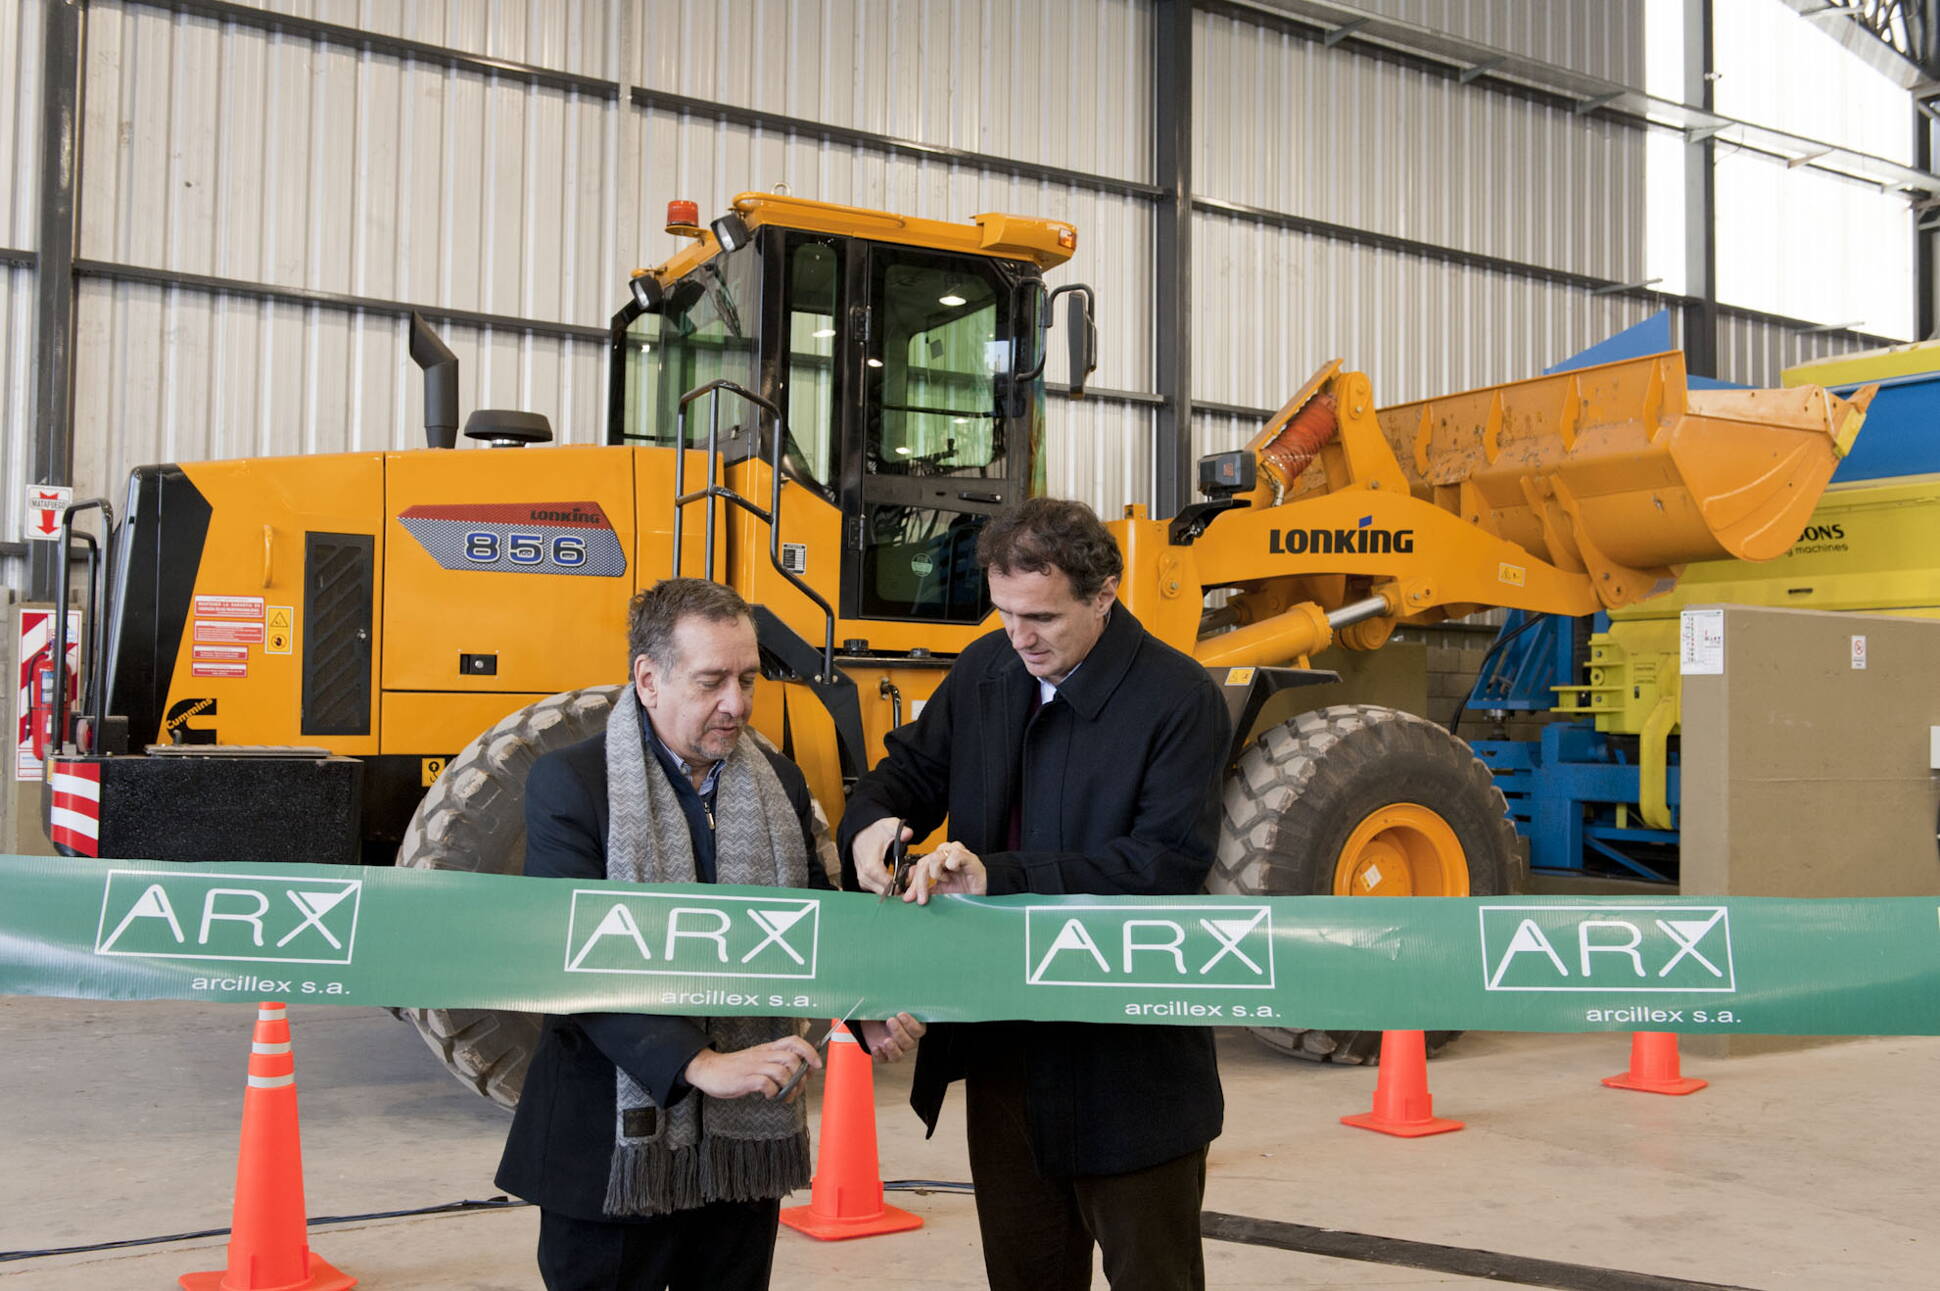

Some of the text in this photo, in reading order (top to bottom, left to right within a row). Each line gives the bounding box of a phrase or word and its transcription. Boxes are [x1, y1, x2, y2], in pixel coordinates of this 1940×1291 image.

[32, 499, 66, 509] MATAFUEGO
[464, 531, 588, 568] 856
[1795, 543, 1849, 555] machines
[166, 698, 214, 730] Cummins
[101, 882, 360, 954] ARX
[570, 901, 818, 969] ARX
[1030, 907, 1269, 983] ARX
[1489, 907, 1727, 989] ARX
[191, 975, 351, 995] arcillex s.a.
[661, 990, 817, 1008] arcillex s.a.
[1125, 1001, 1281, 1018] arcillex s.a.
[1586, 1006, 1742, 1023] arcillex s.a.
